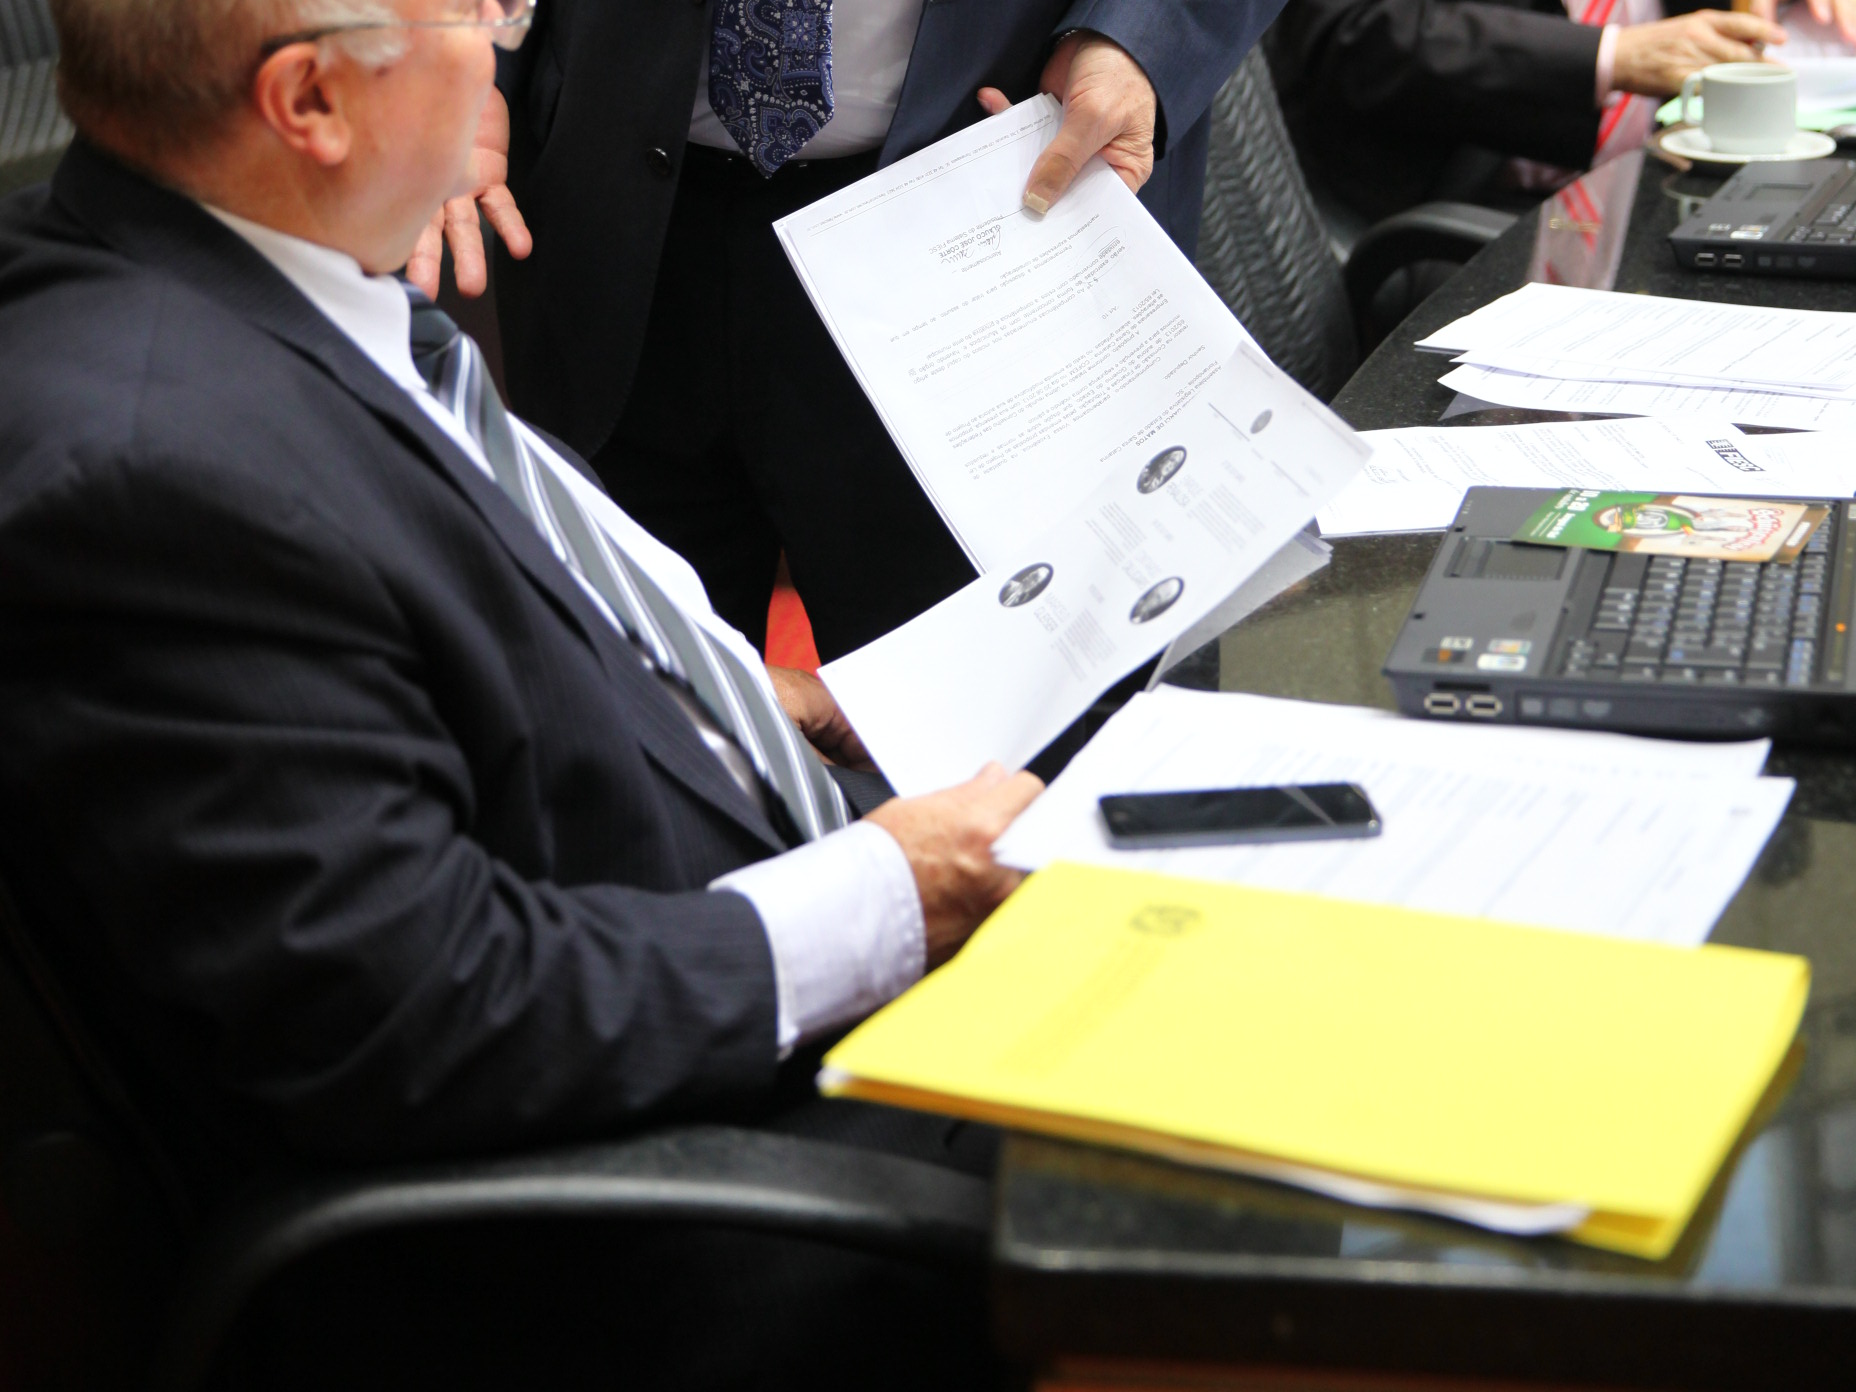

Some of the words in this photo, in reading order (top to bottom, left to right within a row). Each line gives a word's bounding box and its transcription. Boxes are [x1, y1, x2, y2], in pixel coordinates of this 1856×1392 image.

[975, 223, 1001, 239] GLAUCO
[927, 241, 946, 254] FIESC
[1141, 343, 1166, 364] Comissão
[1187, 344, 1206, 360] Senhor
[1086, 352, 1110, 371] conforme
[1187, 359, 1218, 385] Florianópolis
[1193, 364, 1221, 389] Assembleia
[1168, 388, 1195, 410] Legislativa
[1143, 414, 1162, 430] Estado
[1120, 434, 1137, 447] Santa
[1134, 429, 1156, 446] MATOS
[1099, 445, 1122, 462] Catarina
[1717, 449, 1765, 472] FIESC
